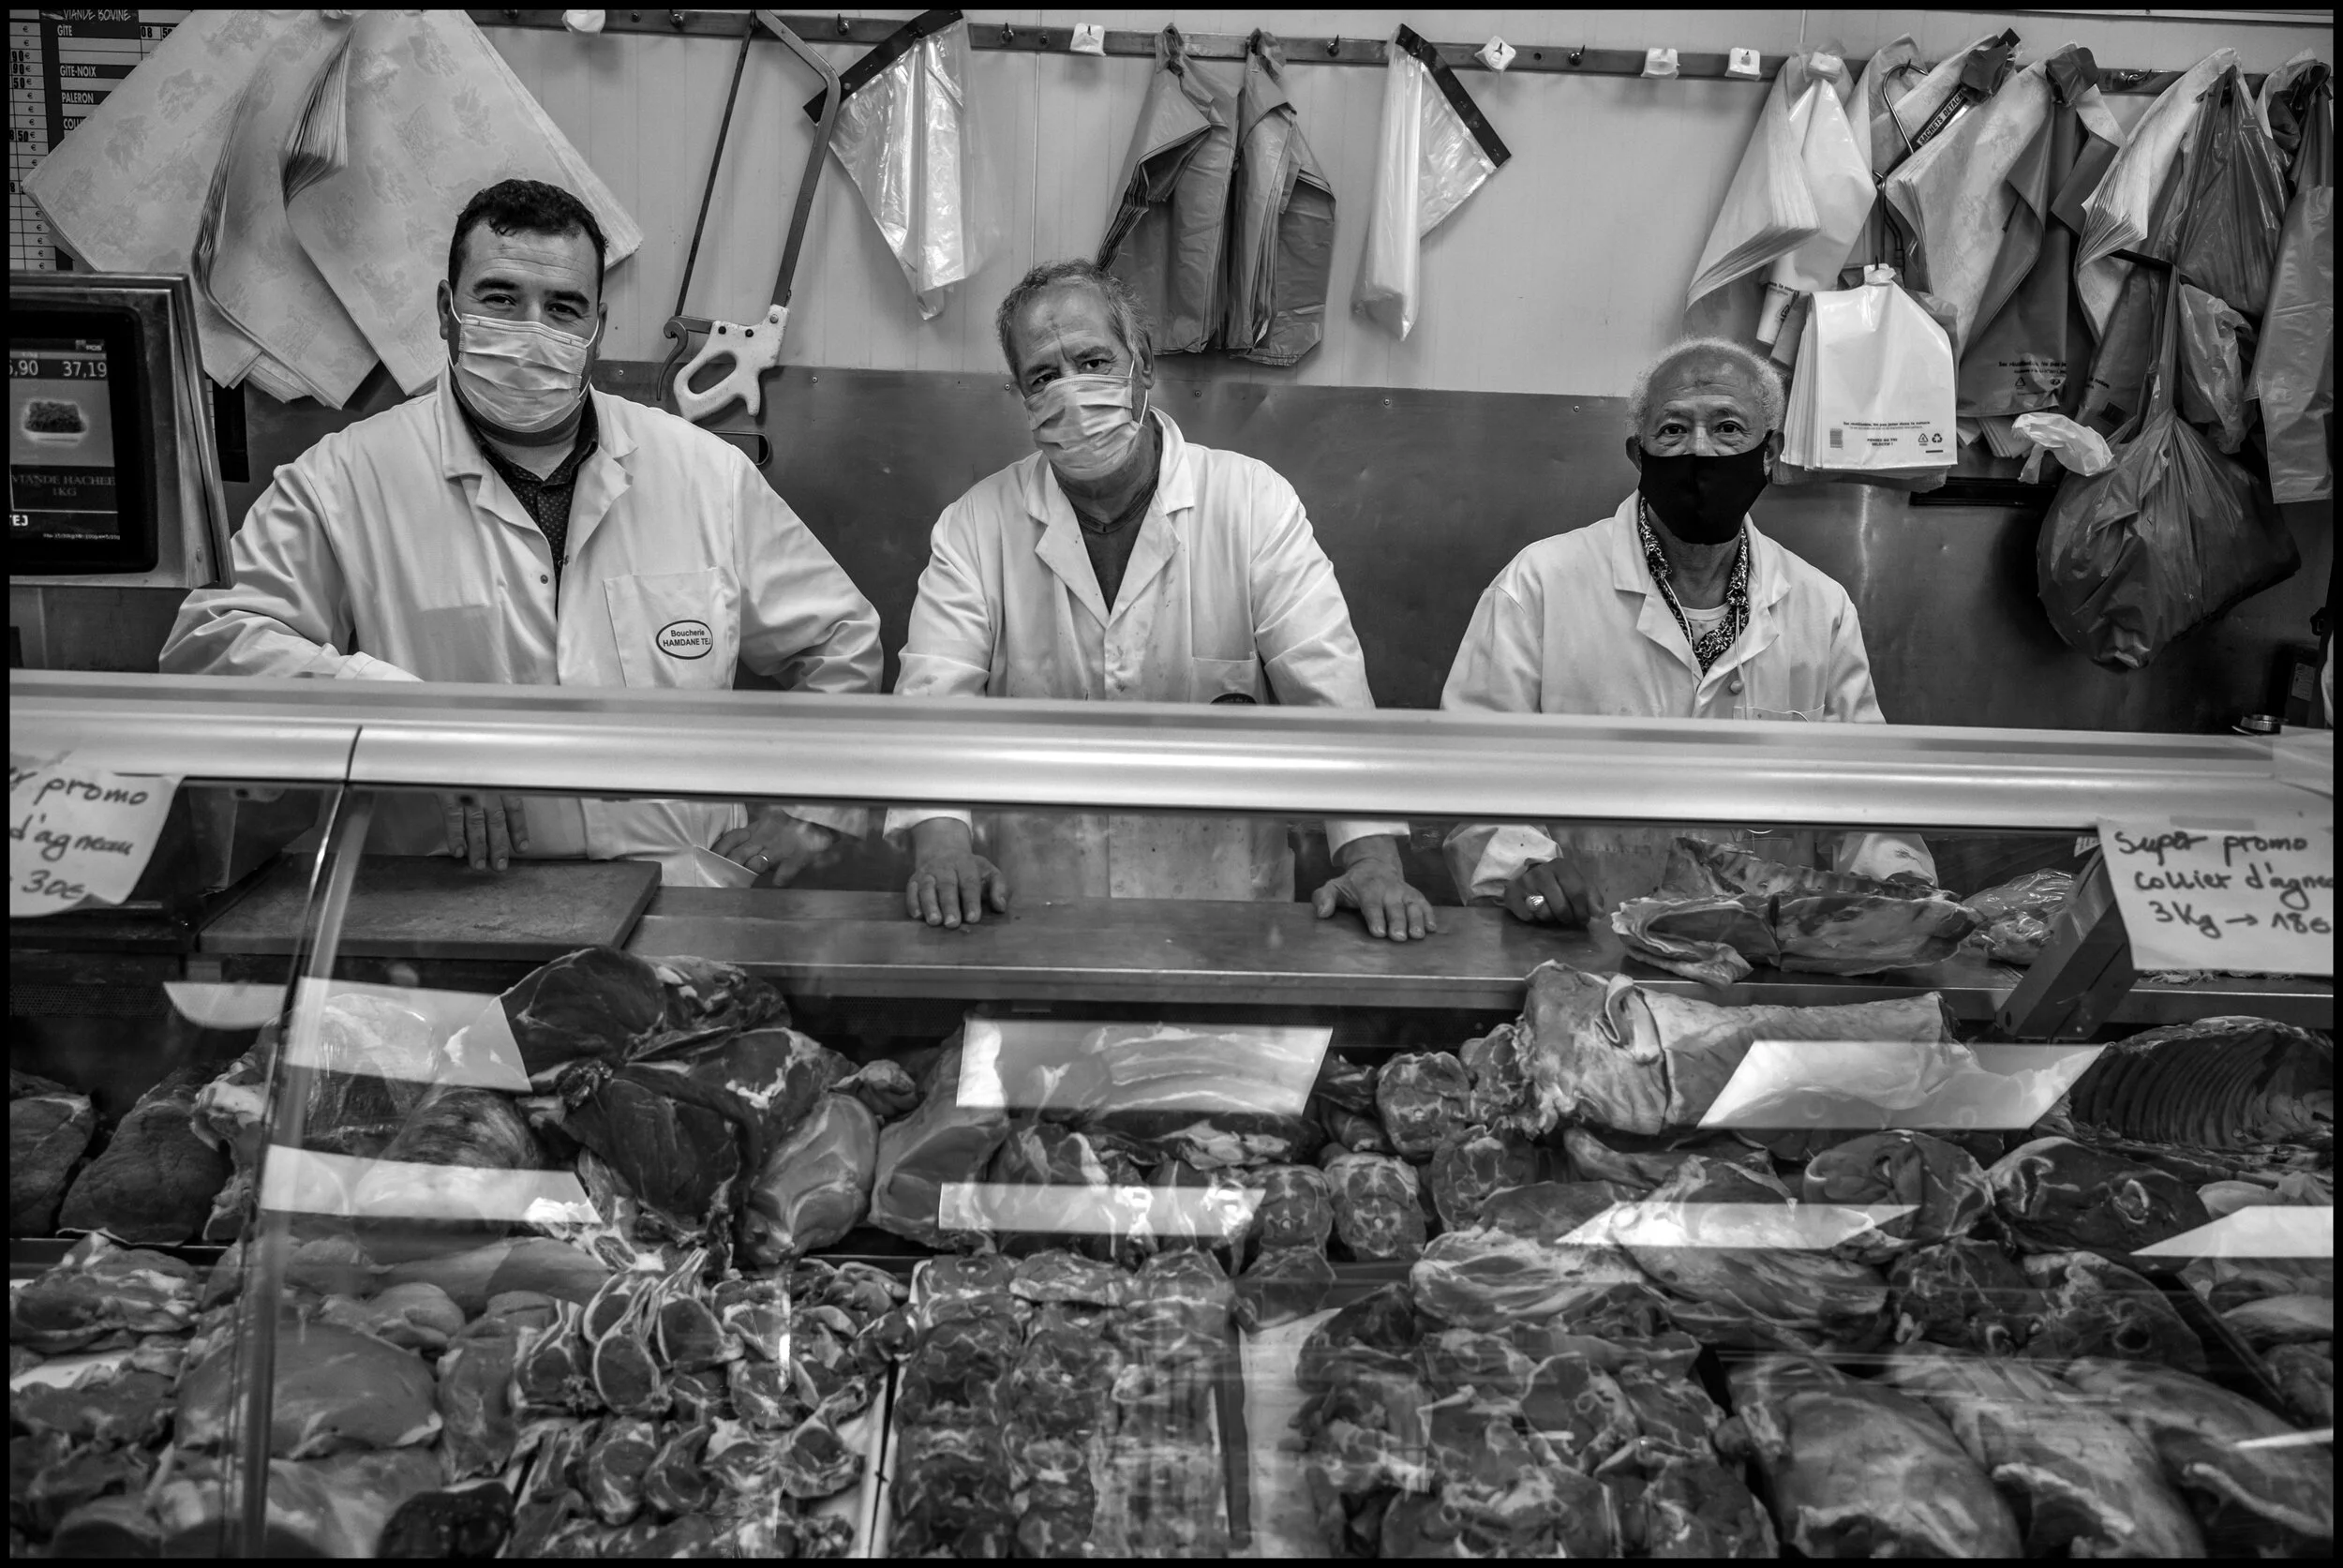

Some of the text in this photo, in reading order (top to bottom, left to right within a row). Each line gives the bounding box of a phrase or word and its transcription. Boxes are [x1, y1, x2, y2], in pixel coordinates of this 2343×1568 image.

[97, 9, 131, 21] BOVINE
[141, 26, 153, 38] 08
[61, 93, 94, 104] PALERON
[1919, 115, 1943, 144] SACHETS
[62, 361, 107, 378] 37,19
[663, 638, 700, 647] HAMDANE
[33, 777, 149, 806] promo
[2113, 829, 2209, 867] Super
[2222, 835, 2308, 867] promo
